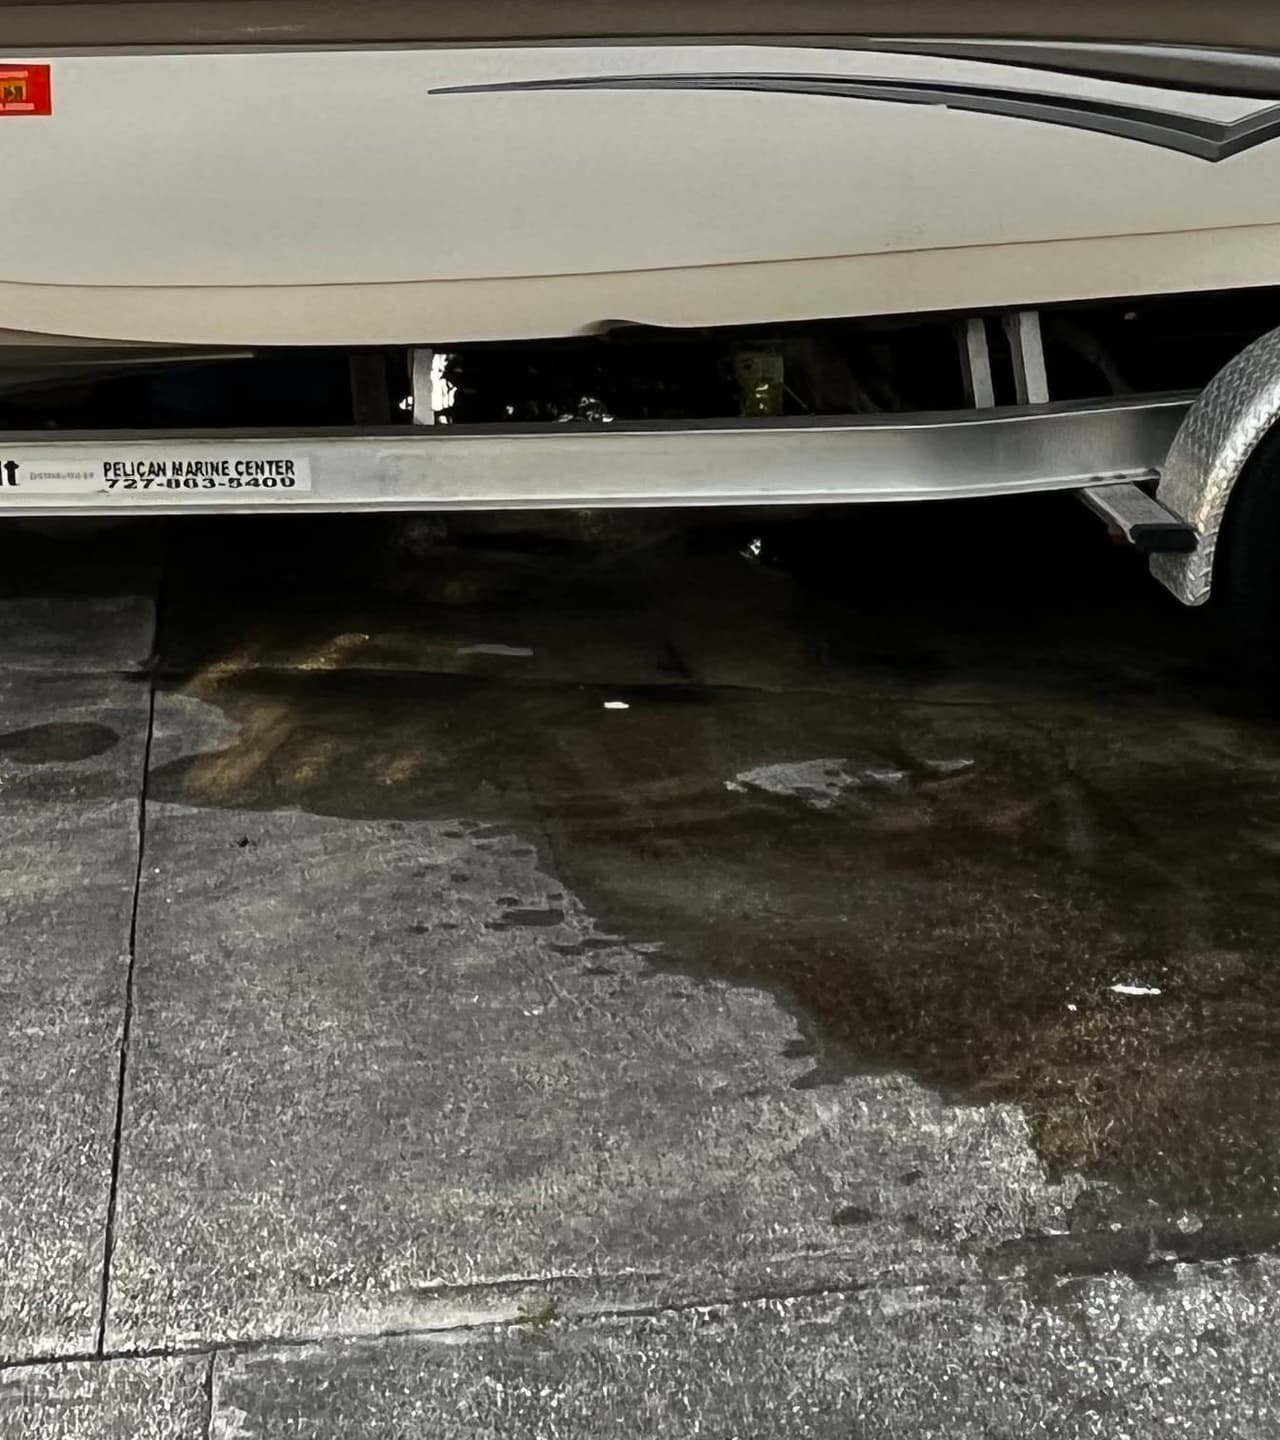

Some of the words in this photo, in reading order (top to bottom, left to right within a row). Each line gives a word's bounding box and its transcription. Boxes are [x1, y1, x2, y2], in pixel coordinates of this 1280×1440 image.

[104, 461, 167, 477] PELICAN
[172, 461, 230, 476] MARINE
[234, 460, 296, 476] CENTER
